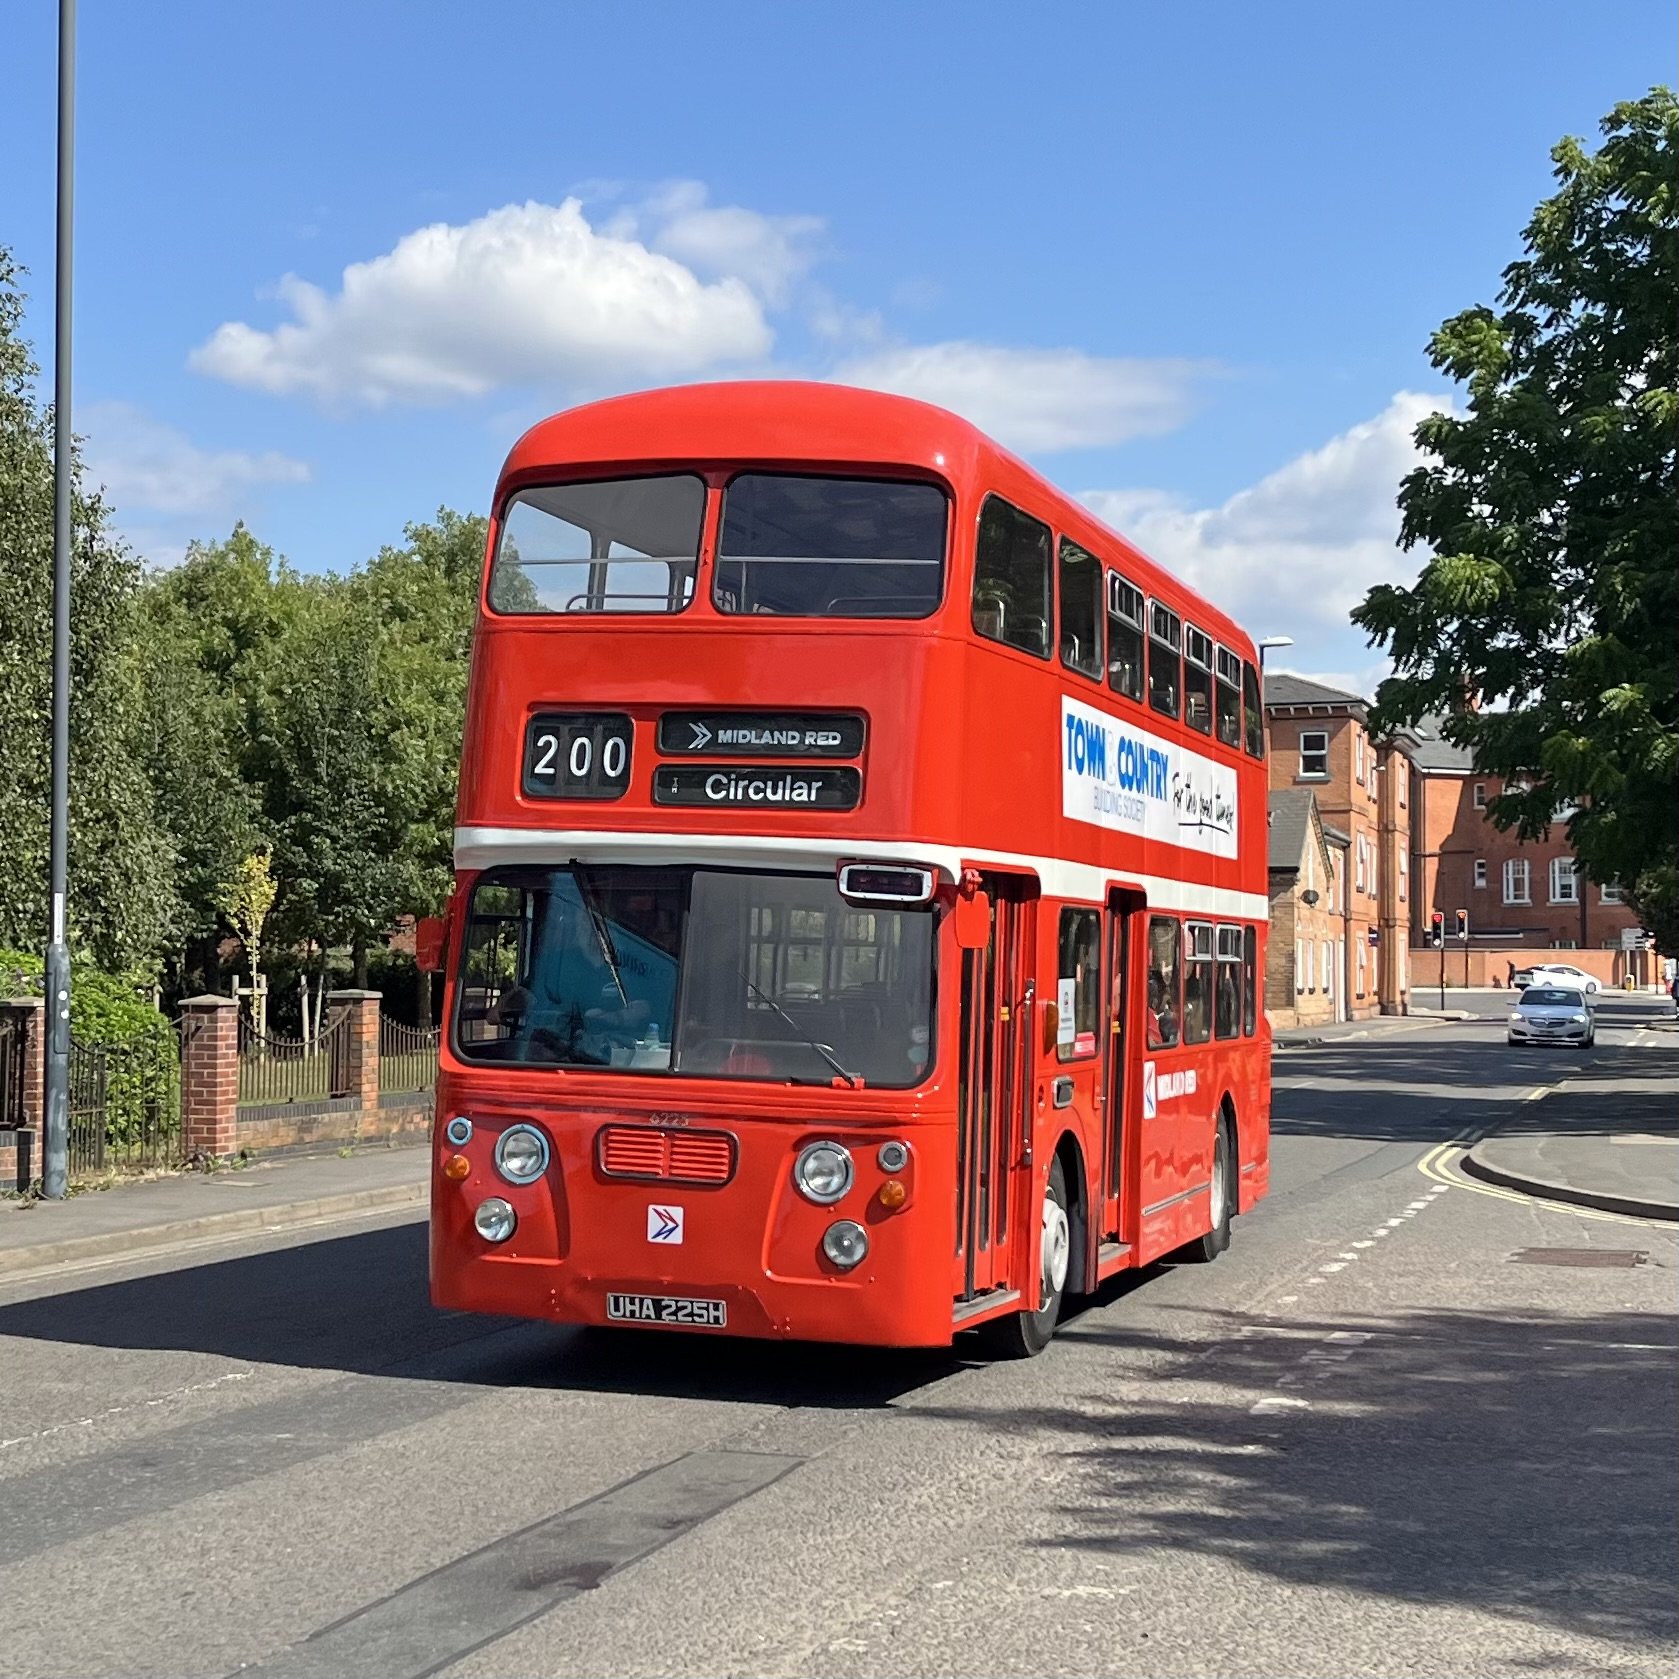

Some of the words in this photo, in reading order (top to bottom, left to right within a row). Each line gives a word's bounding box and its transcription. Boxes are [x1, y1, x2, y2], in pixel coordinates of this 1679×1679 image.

[717, 729, 802, 746] MIDLAND
[804, 730, 841, 747] RED
[533, 734, 627, 778] 200
[1066, 713, 1106, 782] TOWN
[1117, 735, 1169, 802] COUNTRY
[704, 774, 823, 802] Circular
[608, 1296, 656, 1320] UHA
[661, 1300, 724, 1325] 225H
